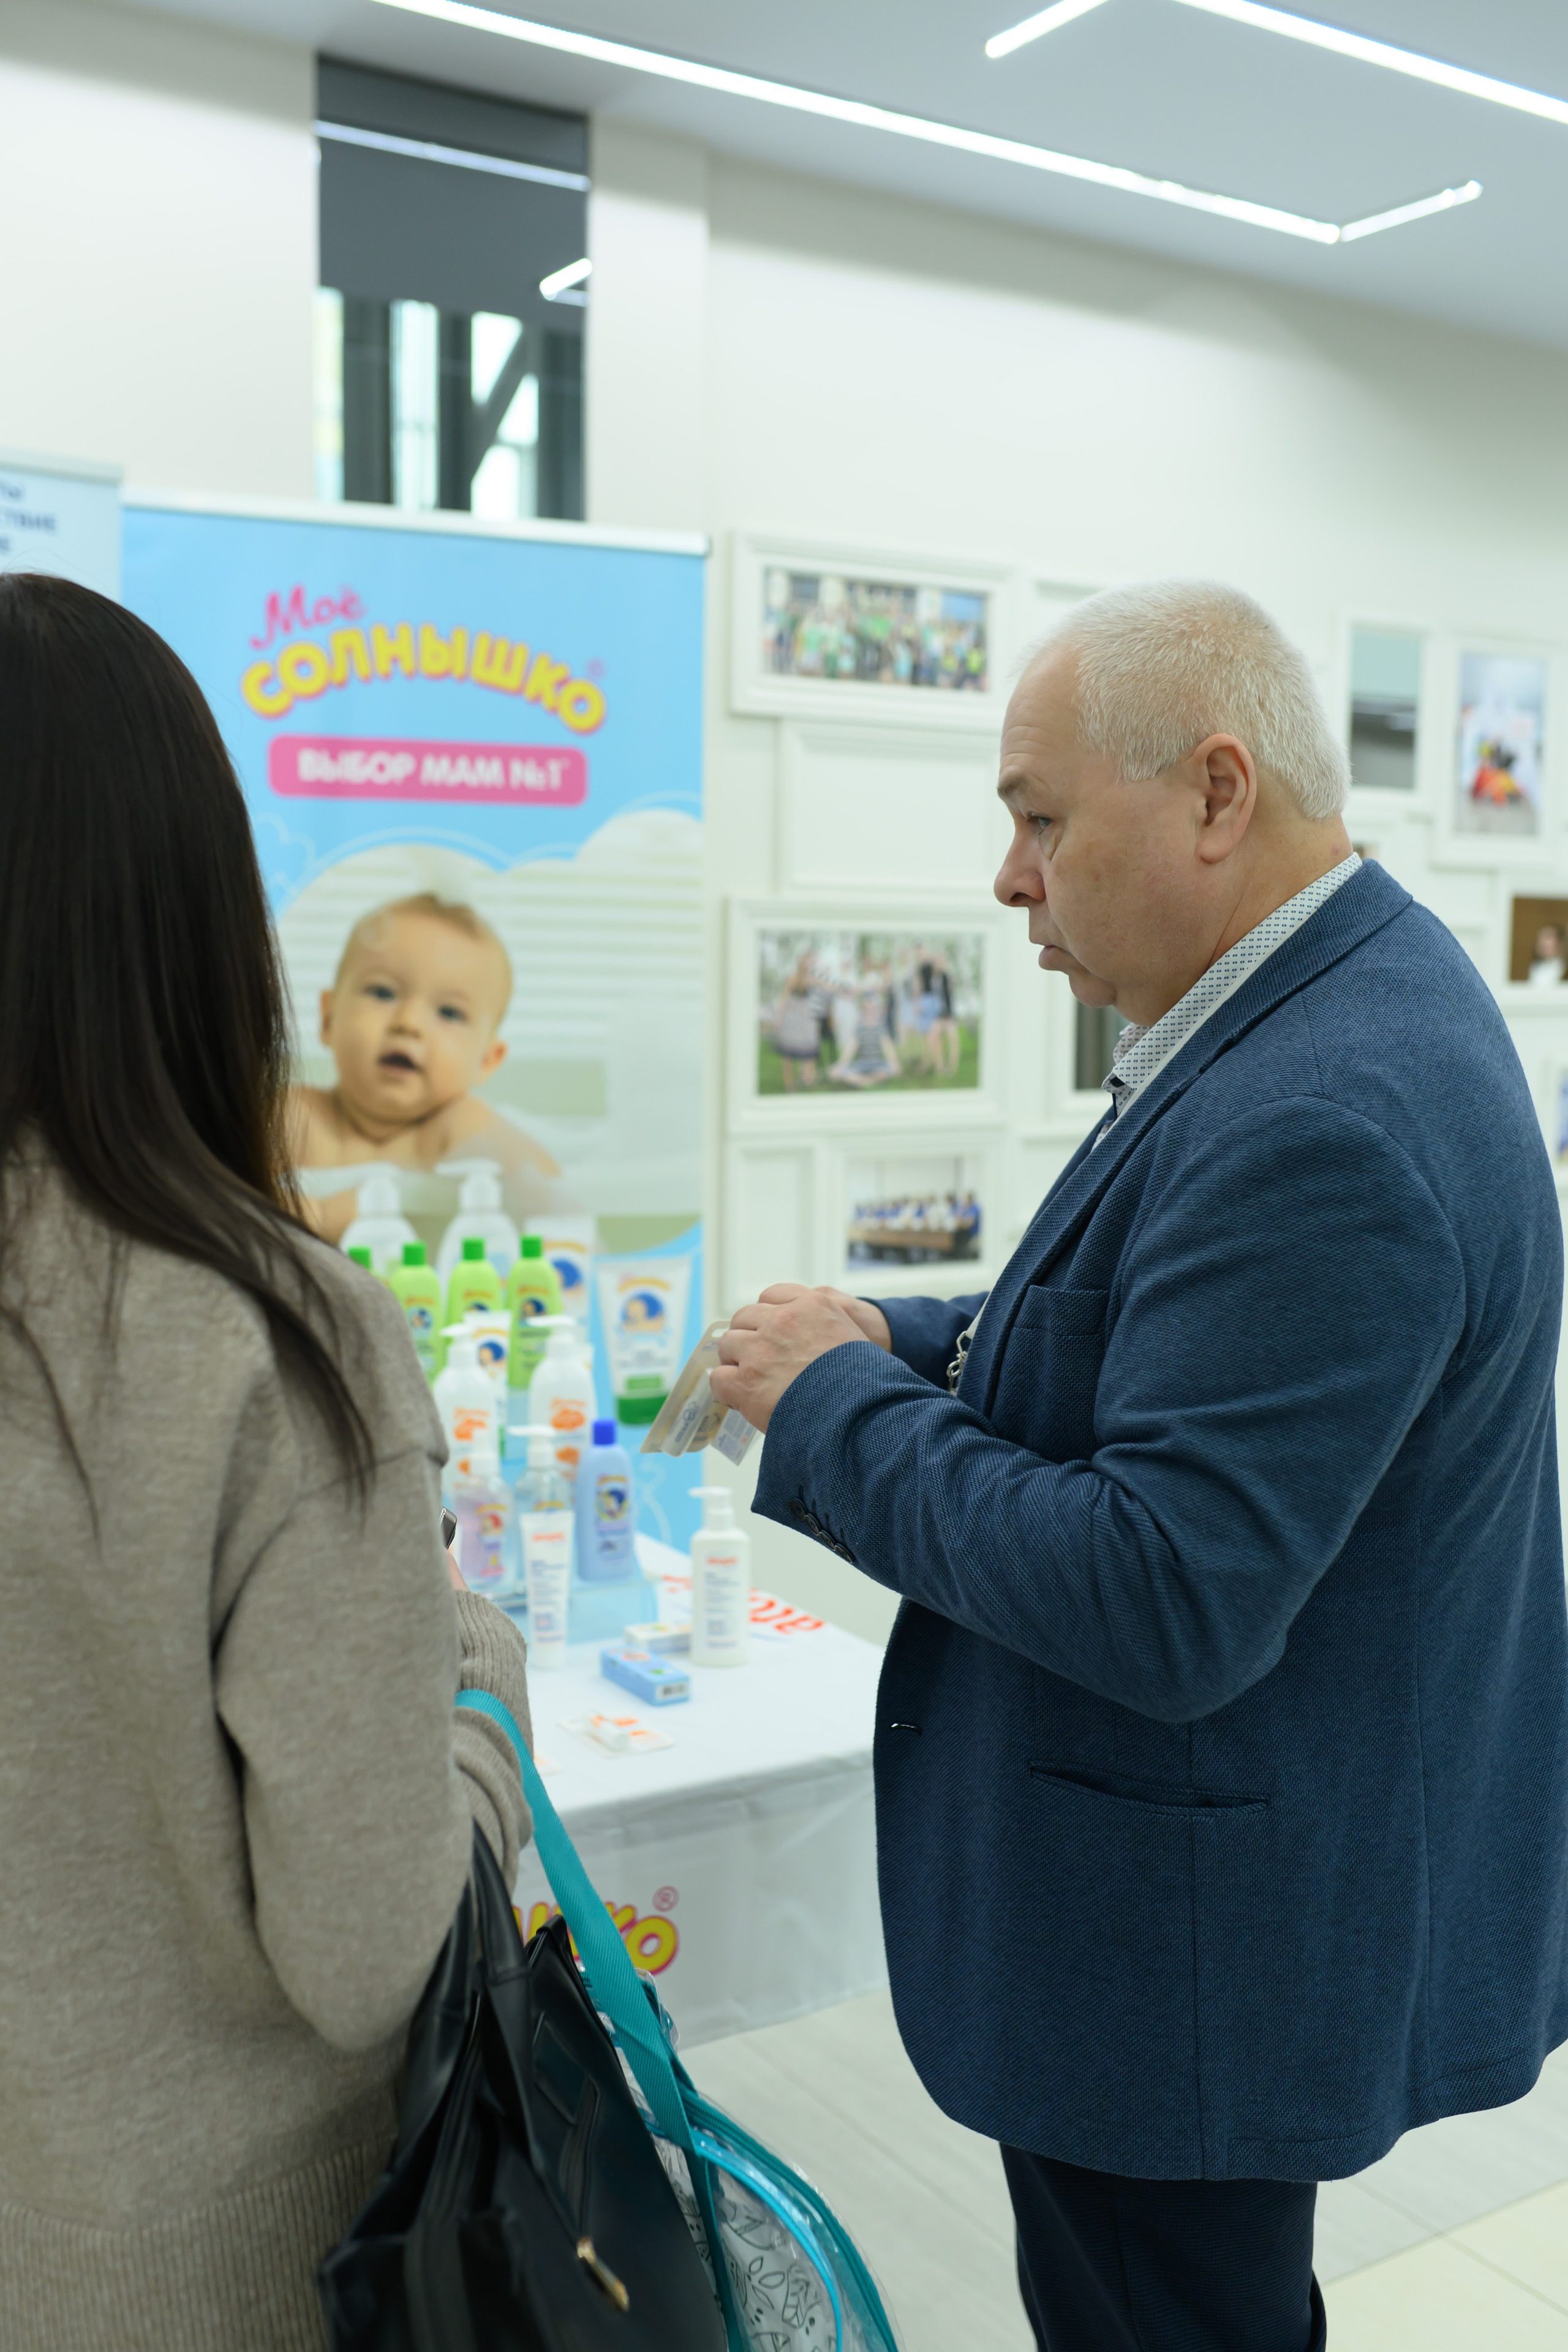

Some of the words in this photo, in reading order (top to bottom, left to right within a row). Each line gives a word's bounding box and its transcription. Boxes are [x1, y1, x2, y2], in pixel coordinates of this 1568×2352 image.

[241, 622, 606, 733] СОЛНЫШКО
[297, 748, 417, 786] ВЫБОР
[420, 752, 505, 790] МАМ
